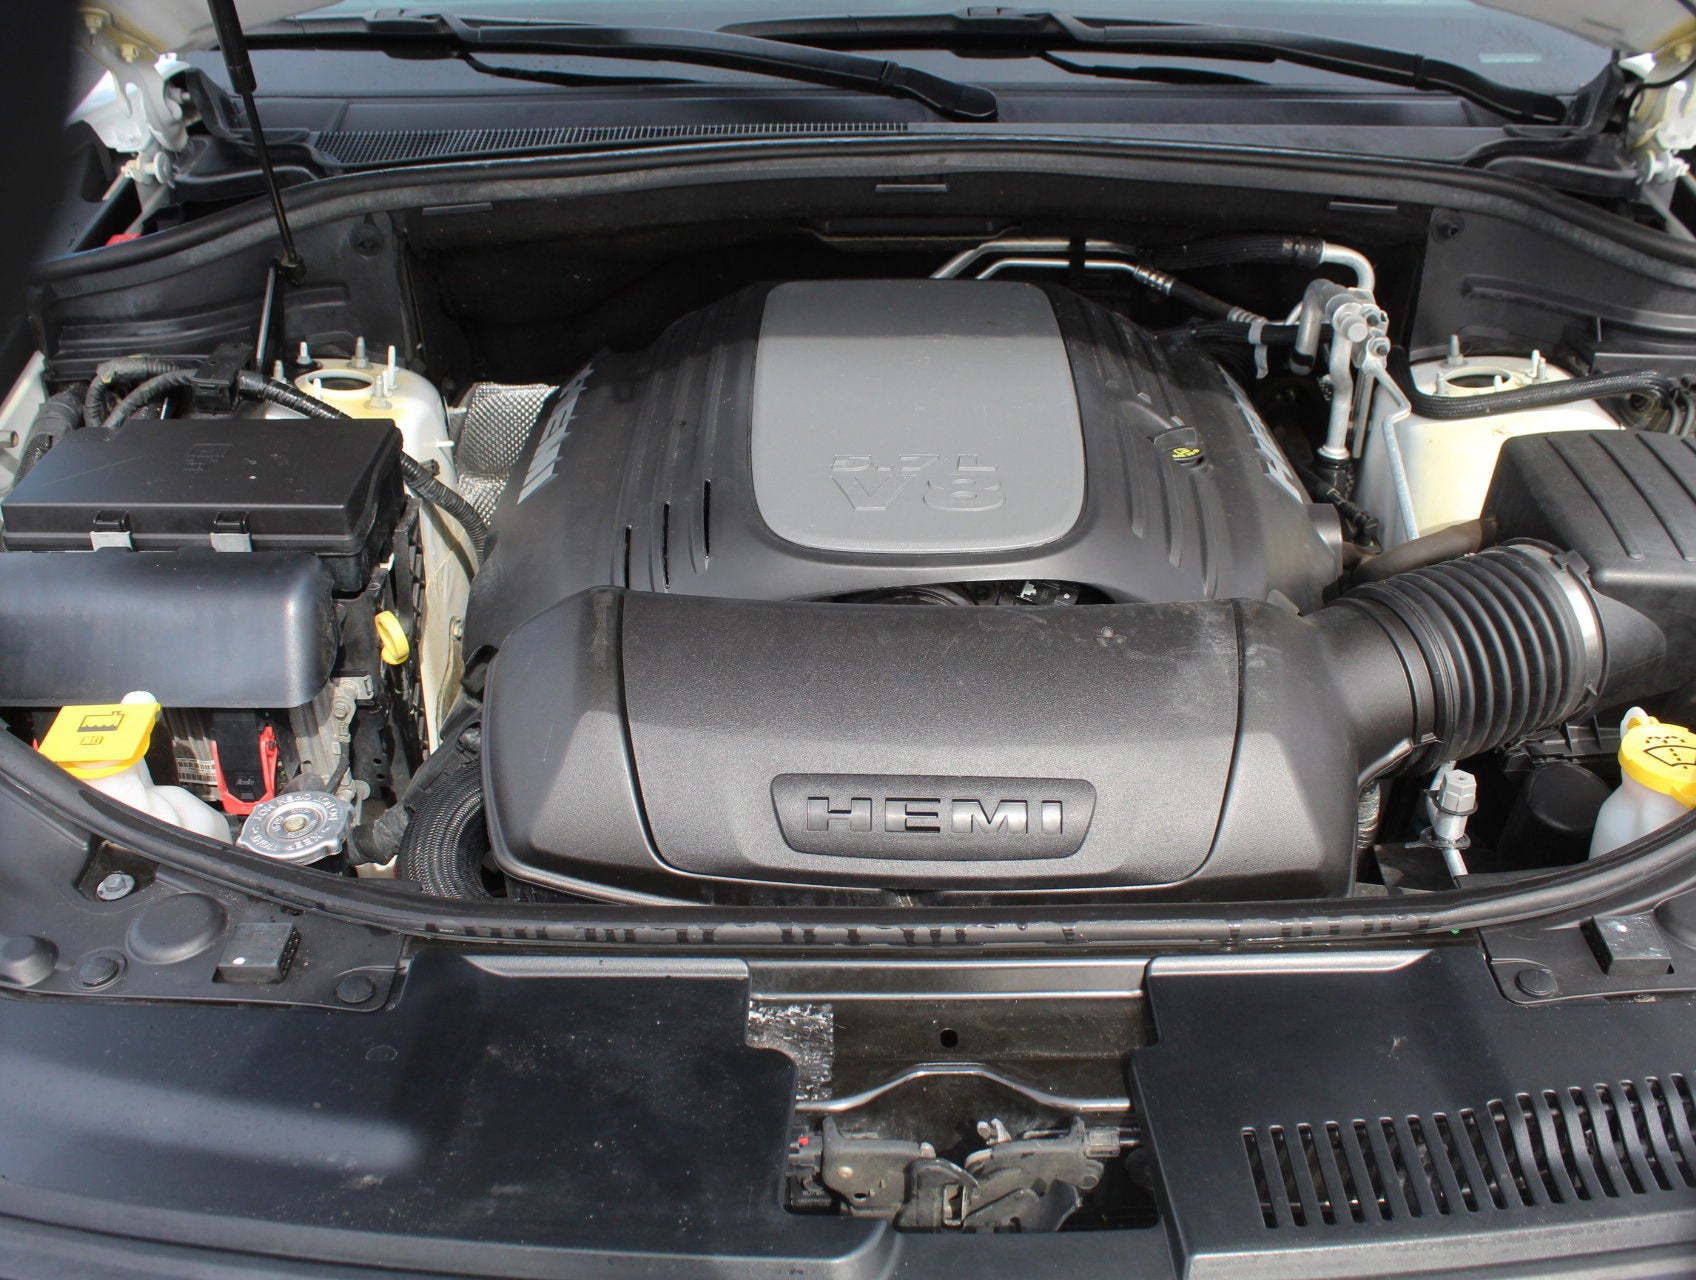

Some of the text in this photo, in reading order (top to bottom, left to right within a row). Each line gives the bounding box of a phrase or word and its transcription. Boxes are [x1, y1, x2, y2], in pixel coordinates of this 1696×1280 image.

[830, 453, 999, 472] 5.7L
[828, 475, 1007, 512] V8
[807, 796, 1063, 835] HEMI
